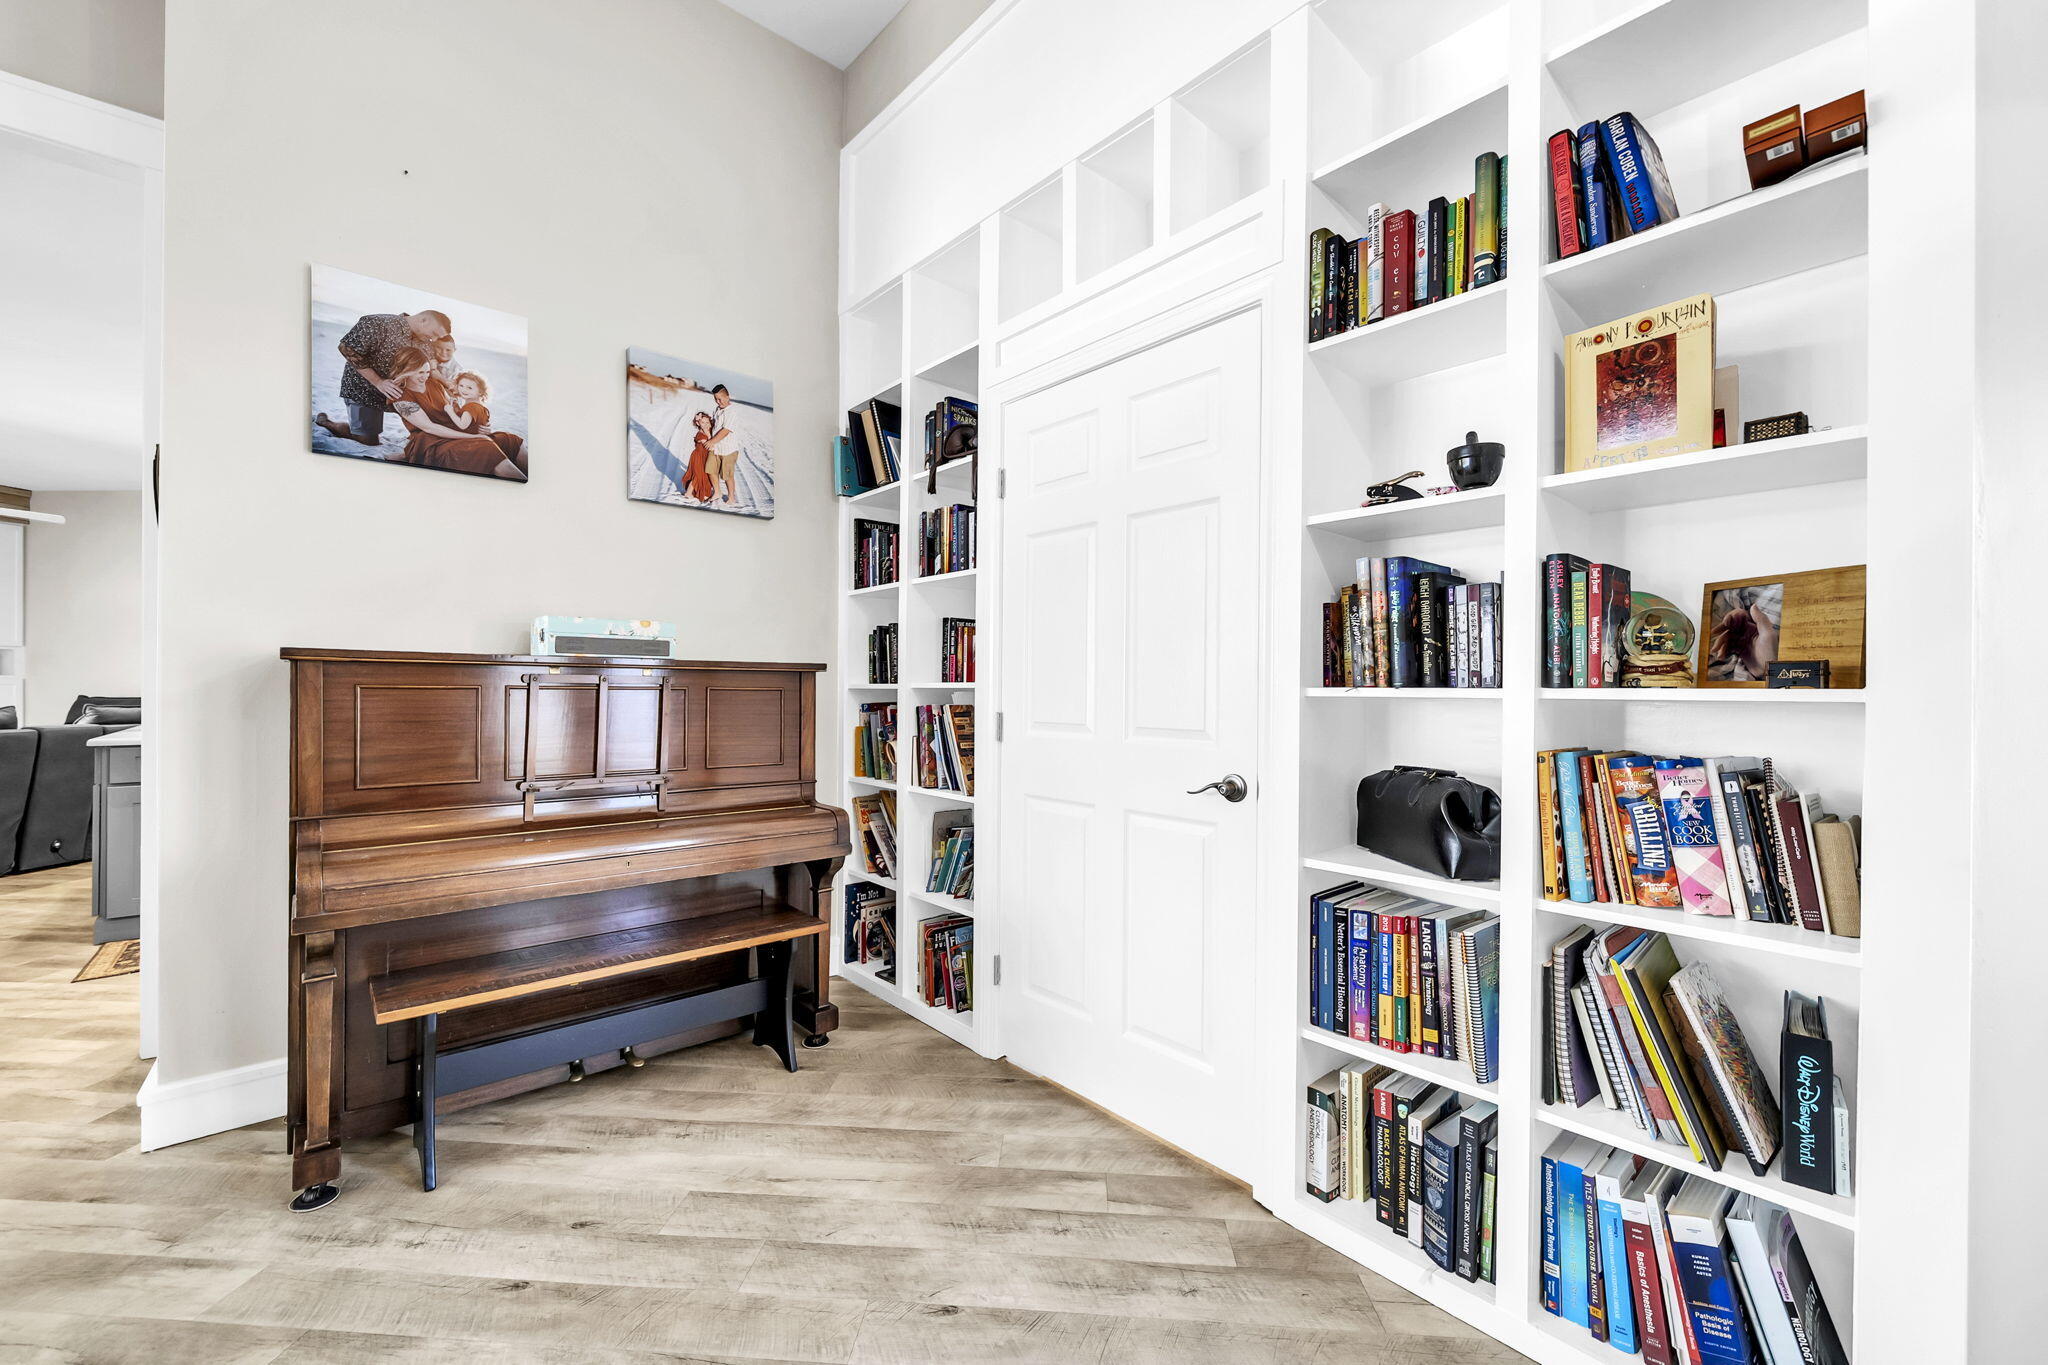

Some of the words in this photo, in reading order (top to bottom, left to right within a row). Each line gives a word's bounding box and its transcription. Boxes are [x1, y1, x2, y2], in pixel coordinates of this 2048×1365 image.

[1607, 116, 1629, 152] HARLAN
[1618, 150, 1638, 182] COBEN
[1589, 203, 1599, 236] Sanderson
[1417, 220, 1426, 250] GUILTY
[954, 414, 977, 426] SPARKS
[1420, 578, 1429, 598] LEIGH
[1556, 560, 1564, 588] ASHLEY
[1573, 582, 1584, 601] DEAR
[1421, 600, 1431, 634] BARDUGO
[1574, 603, 1584, 626] DEBBIE
[1731, 796, 1740, 812] THUG
[1633, 804, 1667, 868] GRILLING
[1672, 825, 1714, 835] COOK
[1675, 835, 1715, 844] BOOK
[1735, 814, 1745, 840] KITCHEN
[857, 893, 867, 901] I'm
[868, 890, 880, 899] Not
[1337, 922, 1345, 951] Netter's
[1422, 921, 1431, 957] LANGE
[1337, 952, 1345, 984] Essential
[1357, 947, 1368, 988] Anatomy
[1336, 986, 1345, 1022] Histology
[1398, 1124, 1406, 1146] ATLAS
[1376, 1126, 1384, 1185] PHARMACOLOGY
[1399, 1146, 1407, 1156] OF
[1799, 1134, 1816, 1167] World
[1408, 1146, 1417, 1195] Histology
[1466, 1162, 1471, 1170] OF
[1398, 1180, 1406, 1213] ANATOMY
[1545, 1163, 1557, 1216] Anesthesiology
[1546, 1217, 1556, 1234] Core
[1586, 1204, 1594, 1239] STUDENT
[1547, 1234, 1556, 1261] Review
[1588, 1240, 1596, 1272] COURSE
[1590, 1273, 1598, 1304] MANUAL
[1635, 1251, 1646, 1278] Basics
[1642, 1284, 1654, 1334] Anesthesia
[1694, 1311, 1734, 1326] Pathologic
[1701, 1320, 1722, 1330] Basis
[1776, 1271, 1790, 1301] Blueprints
[1790, 1317, 1814, 1363] NEUROLOGY
[1703, 1327, 1732, 1340] Disease
